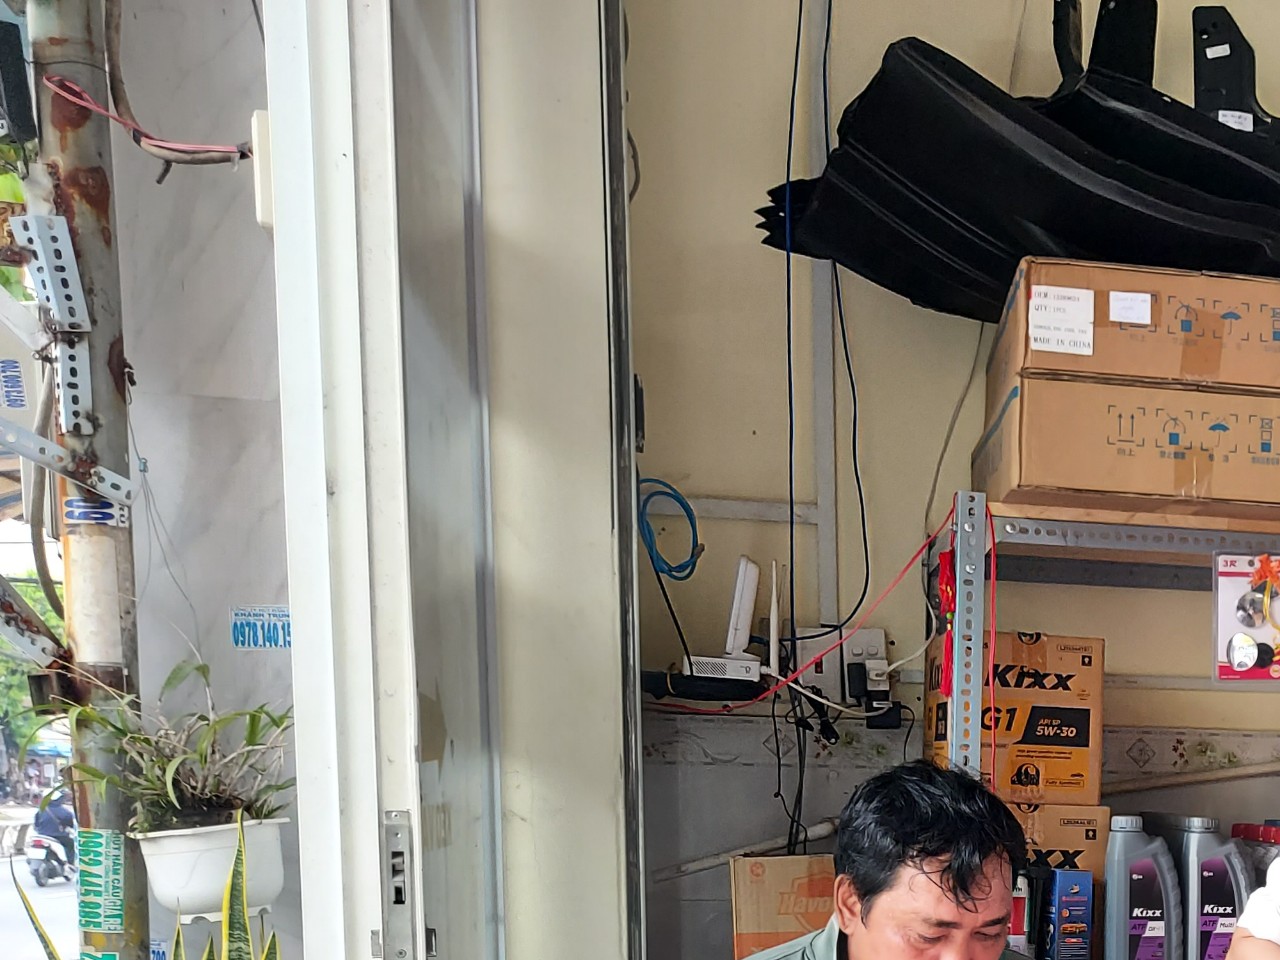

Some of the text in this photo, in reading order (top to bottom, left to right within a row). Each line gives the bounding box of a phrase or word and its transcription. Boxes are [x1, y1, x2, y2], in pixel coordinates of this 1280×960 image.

[1033, 336, 1051, 345] MADE
[1068, 341, 1091, 349] CHINA
[983, 663, 1076, 692] Kixx
[981, 706, 1018, 732] G1
[1035, 726, 1077, 738] 5W-30
[1027, 849, 1086, 869] xx
[1132, 907, 1162, 917] Kixx
[1203, 904, 1234, 914] Kixx
[1131, 923, 1147, 931] ATF
[1202, 919, 1217, 928] ATF
